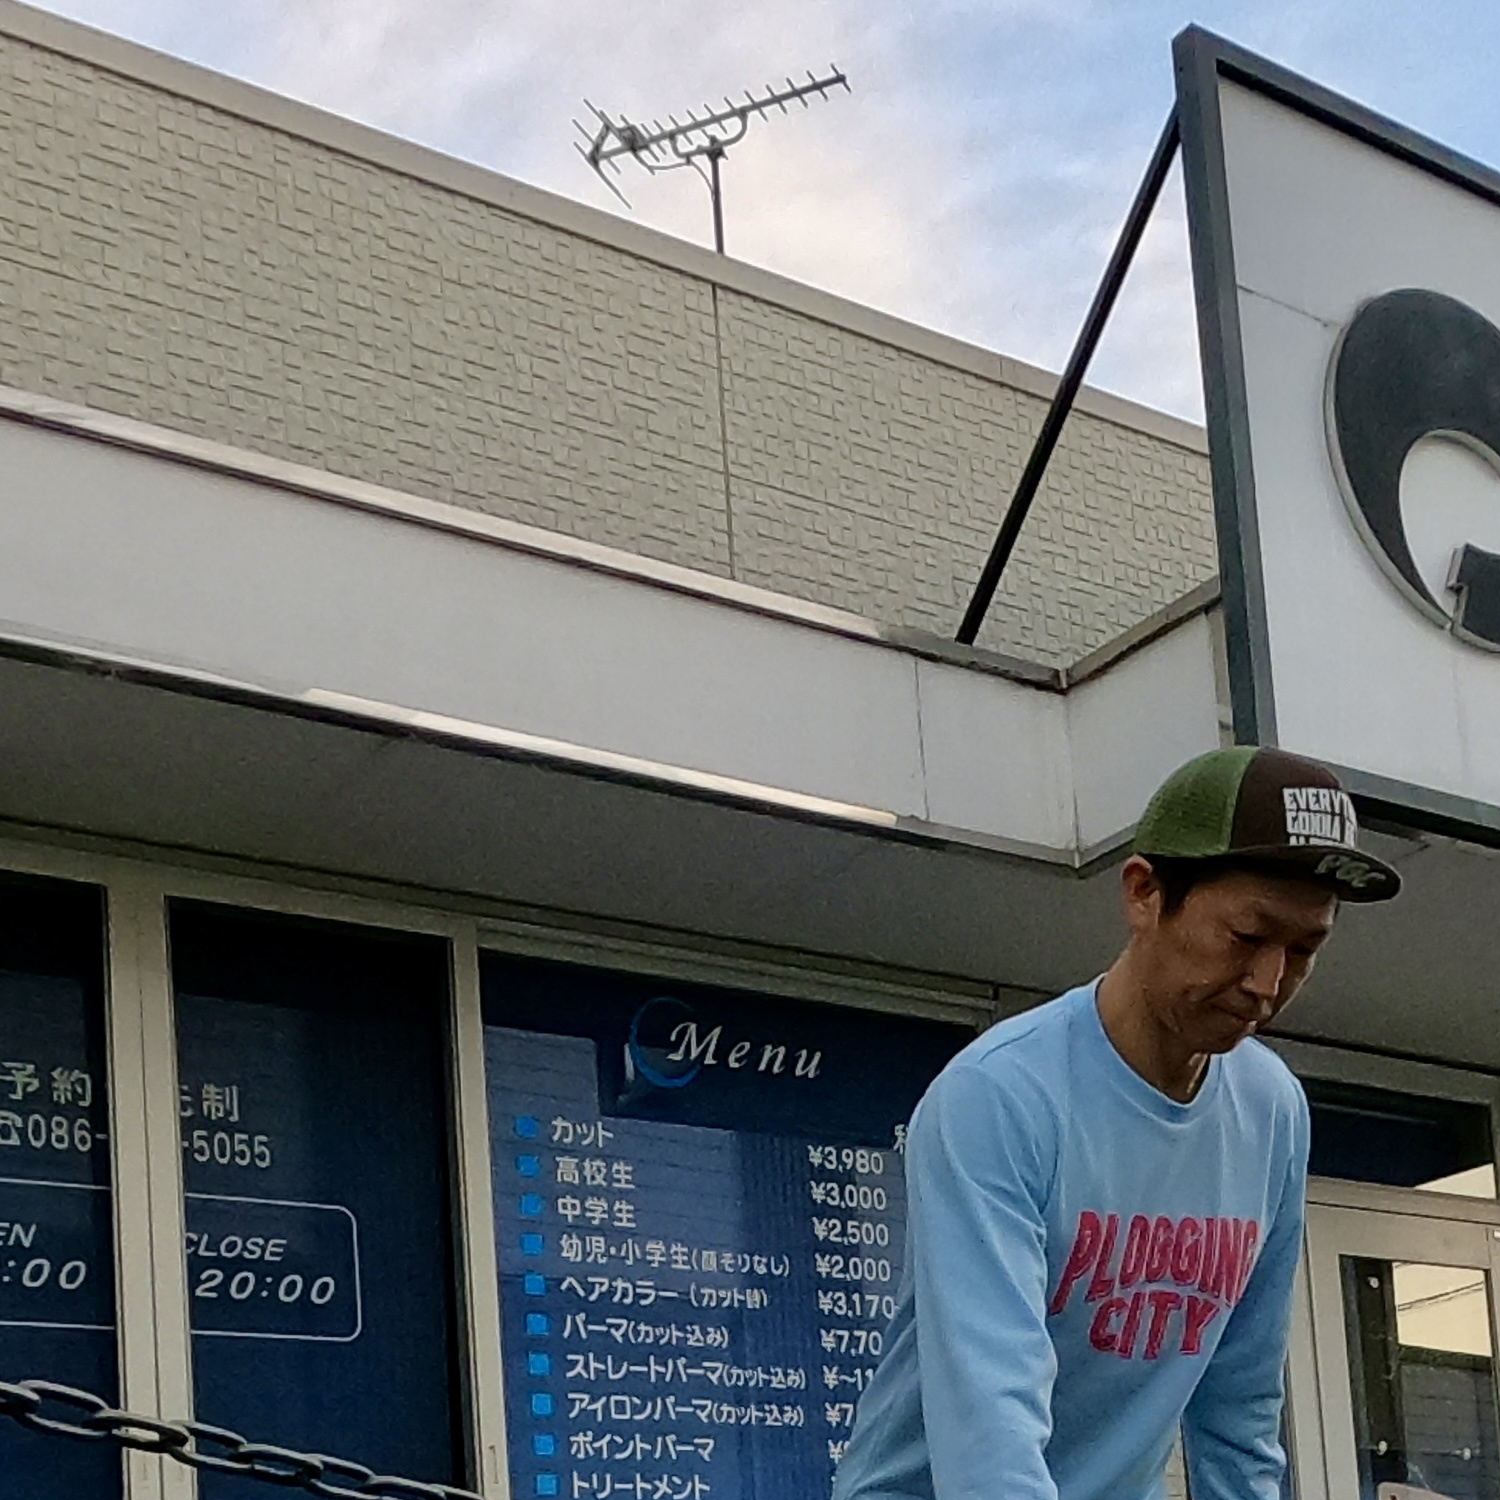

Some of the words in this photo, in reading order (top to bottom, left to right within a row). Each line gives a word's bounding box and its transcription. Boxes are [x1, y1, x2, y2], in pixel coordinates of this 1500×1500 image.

[667, 1022, 823, 1078] Menu
[0, 1062, 92, 1107] 予約
[551, 1117, 614, 1148] カット
[807, 1145, 883, 1174] ¥3,980
[555, 1156, 636, 1190] 高校生
[810, 1181, 886, 1210] ¥3,000
[556, 1196, 636, 1229] 中学生
[812, 1217, 889, 1246] ¥2,500
[195, 1269, 335, 1304] 20:00
[815, 1253, 891, 1282] ¥2,000
[560, 1278, 679, 1307] ヘアカラー
[1089, 1290, 1219, 1359] CITY
[569, 1432, 715, 1462] ポイントパーマ
